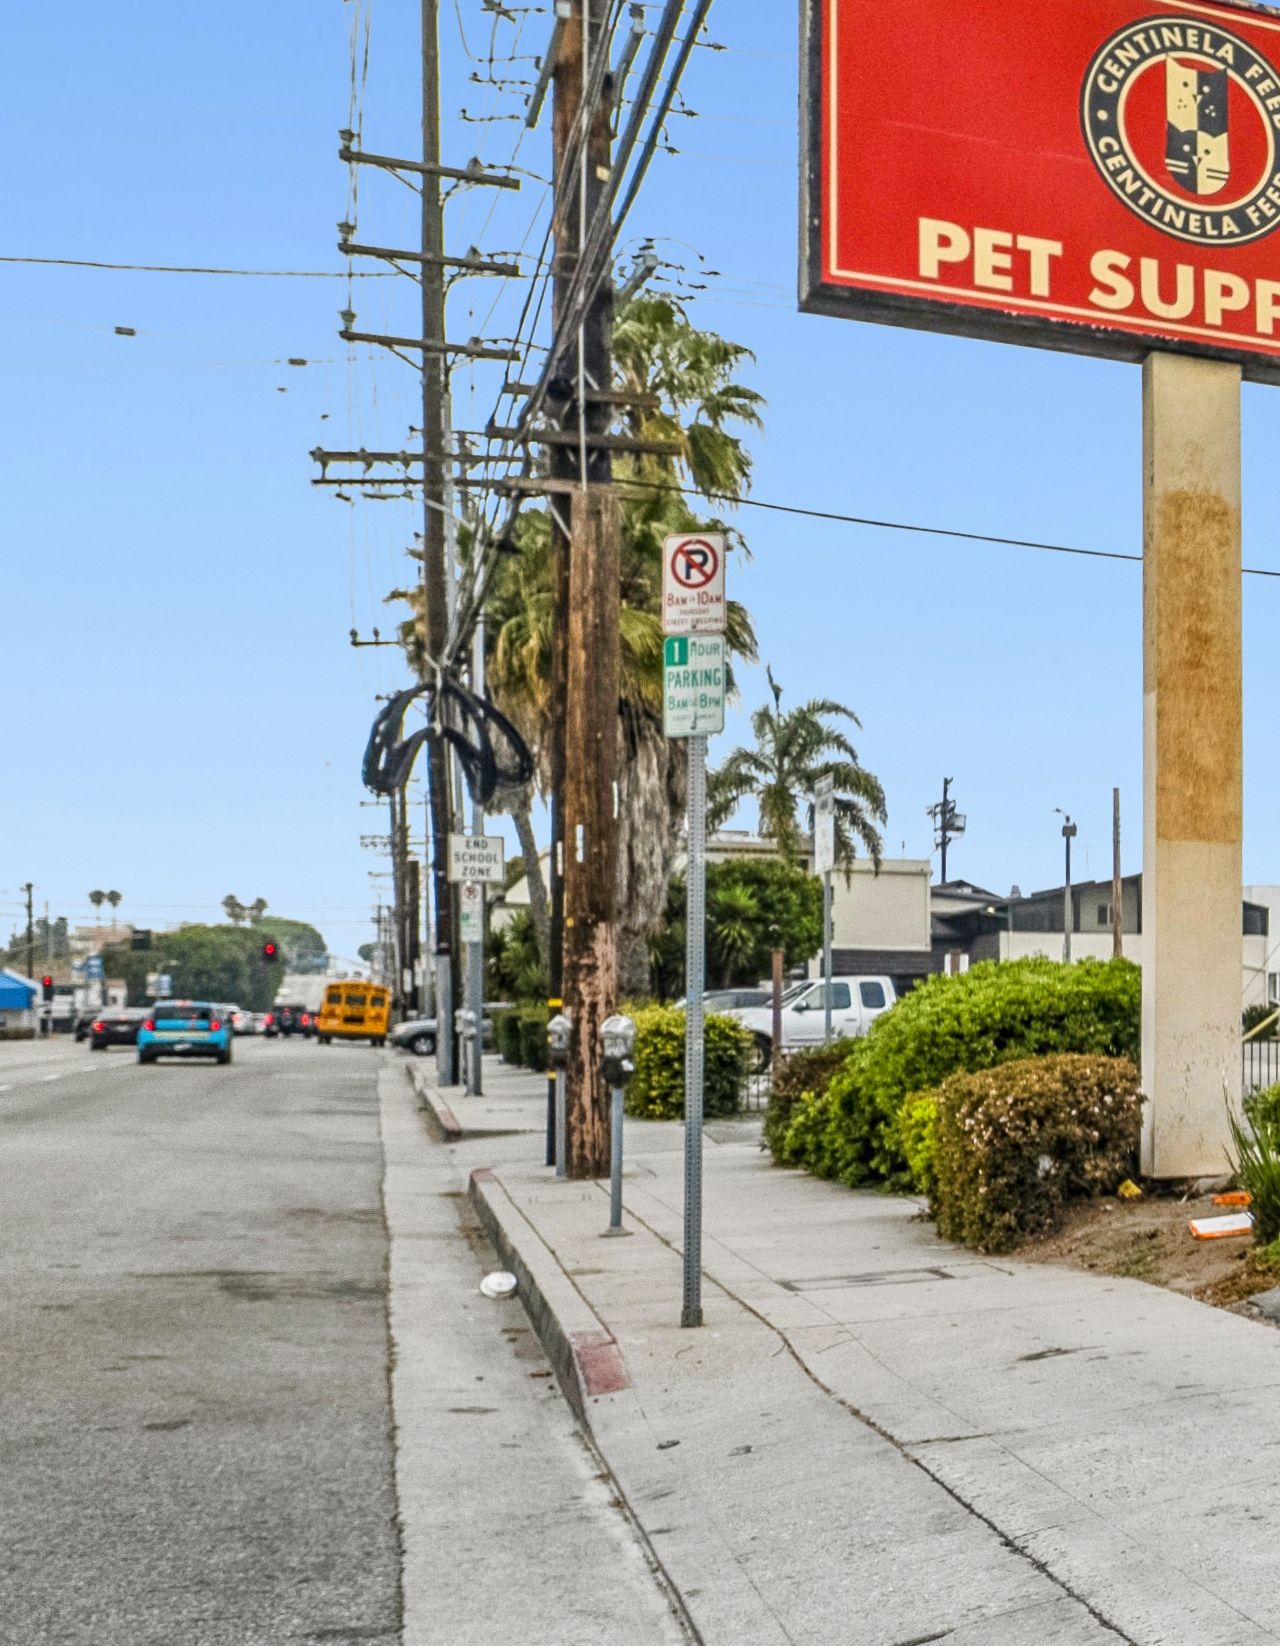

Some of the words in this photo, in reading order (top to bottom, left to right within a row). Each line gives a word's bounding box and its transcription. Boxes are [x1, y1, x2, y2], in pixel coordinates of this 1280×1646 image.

[1097, 27, 1234, 93] CENTINELA
[1098, 136, 1241, 236] CENTINELA
[918, 217, 1063, 297] PET
[668, 668, 721, 689] PARKING
[466, 840, 488, 851] END
[454, 851, 498, 865] SCHOOL
[462, 866, 491, 877] ZONE
